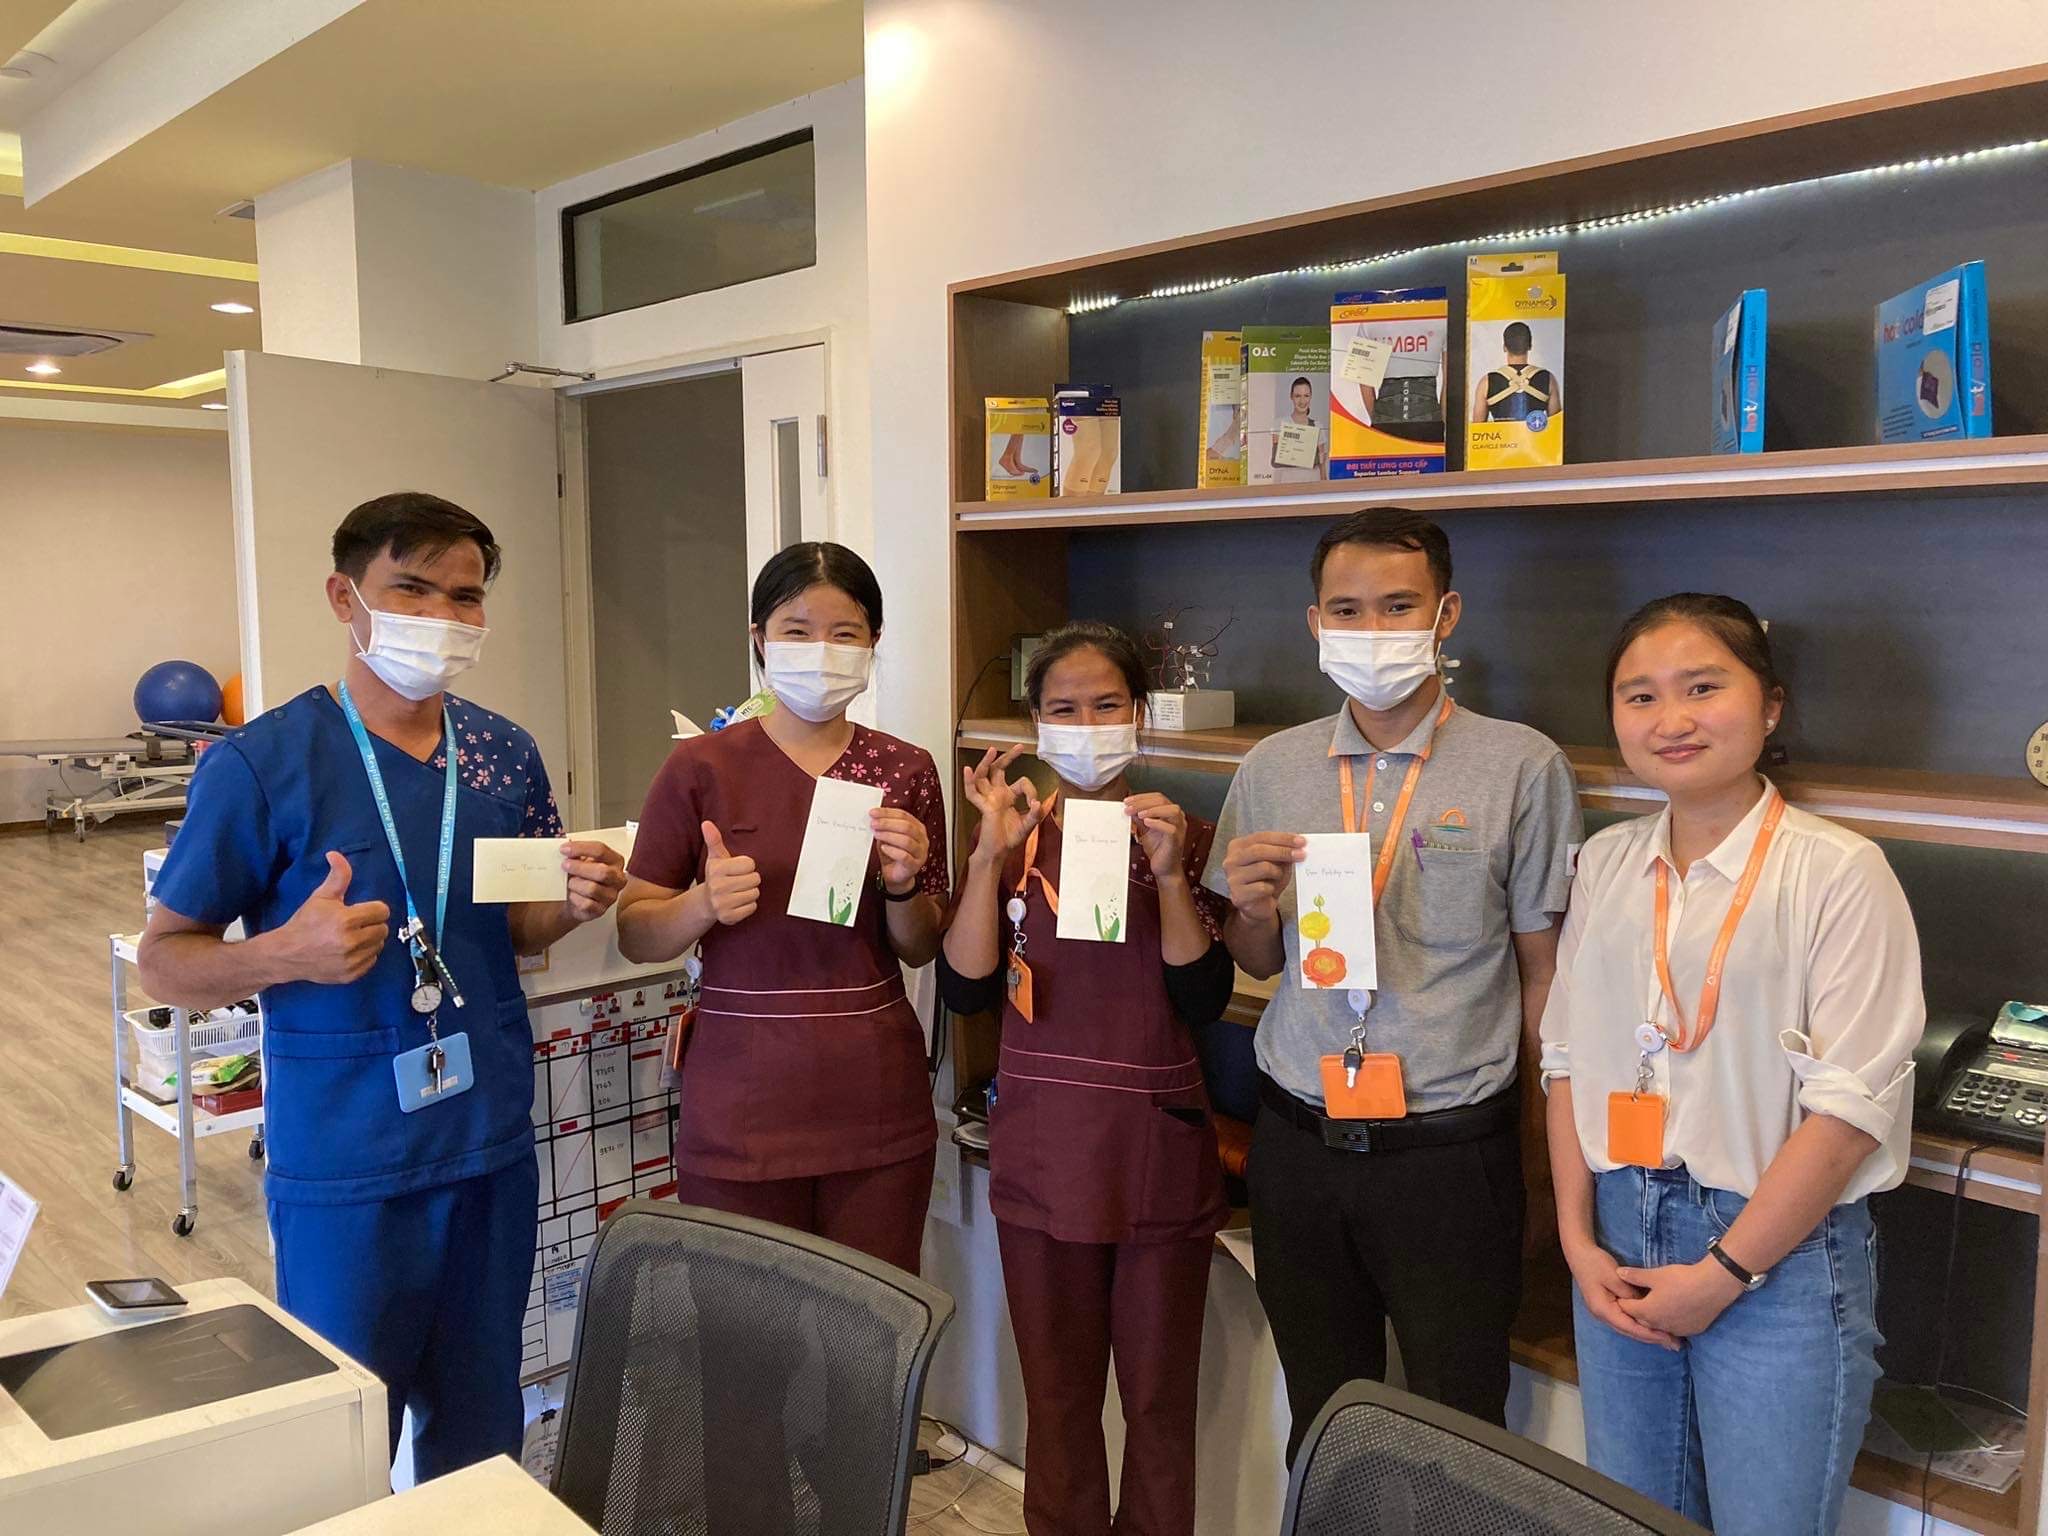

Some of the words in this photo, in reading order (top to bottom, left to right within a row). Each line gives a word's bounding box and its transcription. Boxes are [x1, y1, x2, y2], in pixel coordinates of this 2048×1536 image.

[1472, 432, 1502, 441] DYNA
[366, 753, 385, 801] Respiratory
[381, 802, 393, 821] Care
[442, 786, 454, 825] Specialist
[441, 825, 450, 845] Care
[437, 845, 449, 894] Respiratory
